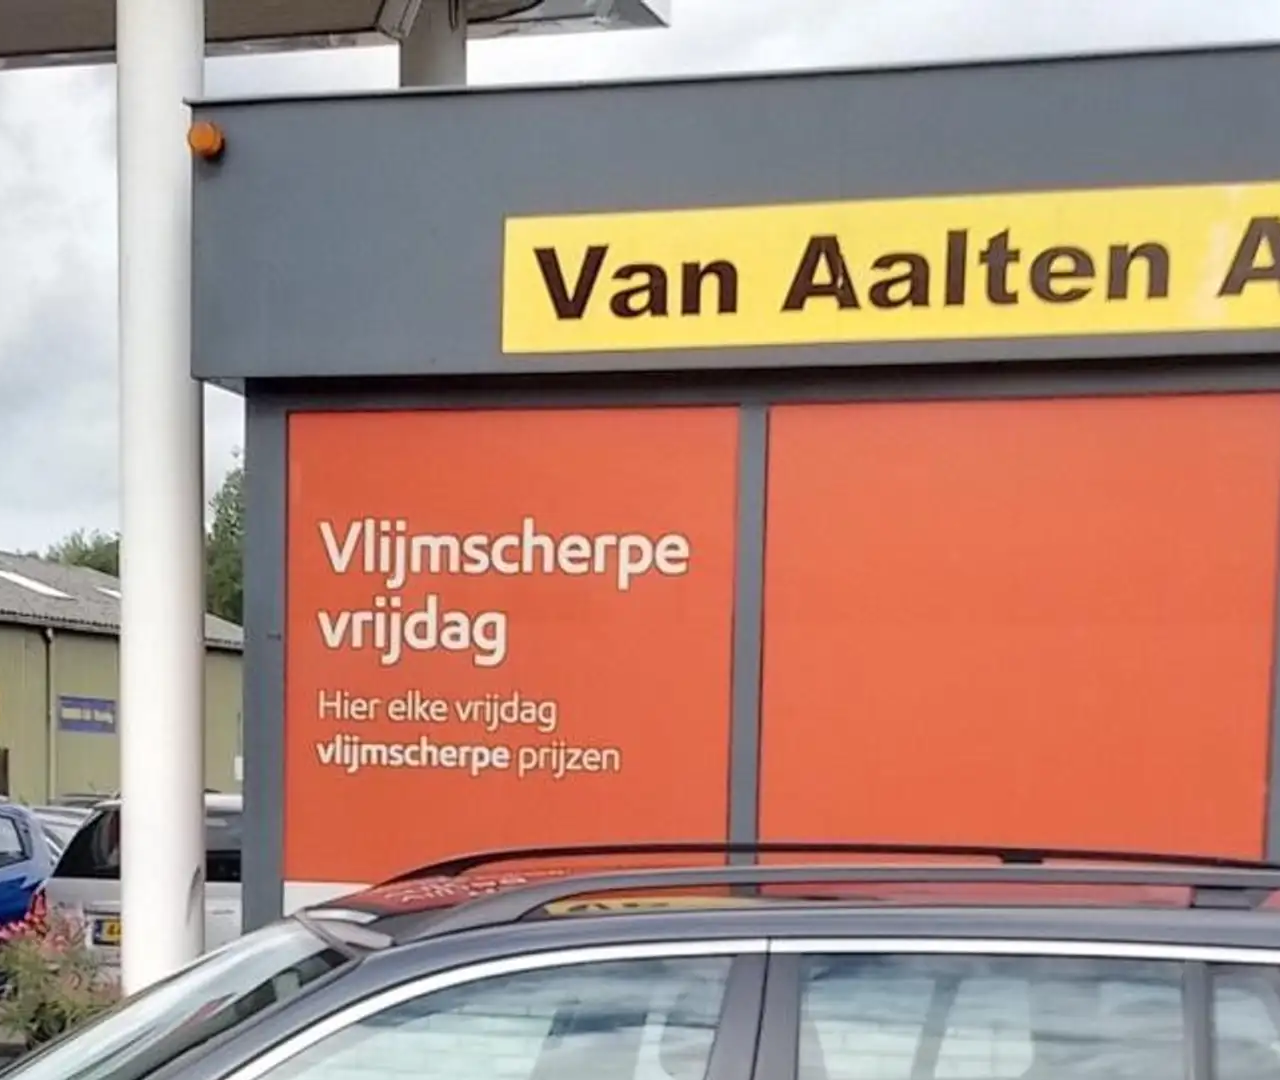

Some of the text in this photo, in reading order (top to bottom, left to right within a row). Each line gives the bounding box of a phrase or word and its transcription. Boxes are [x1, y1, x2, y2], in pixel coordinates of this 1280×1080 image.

[533, 244, 739, 321] Van
[780, 228, 1171, 312] Aalten
[319, 517, 690, 590] Vlijmscherpe
[317, 594, 508, 667] vrijdag
[317, 690, 558, 732] Hier elke vrijdag
[316, 734, 621, 778] vlijmscherpe prijzen
